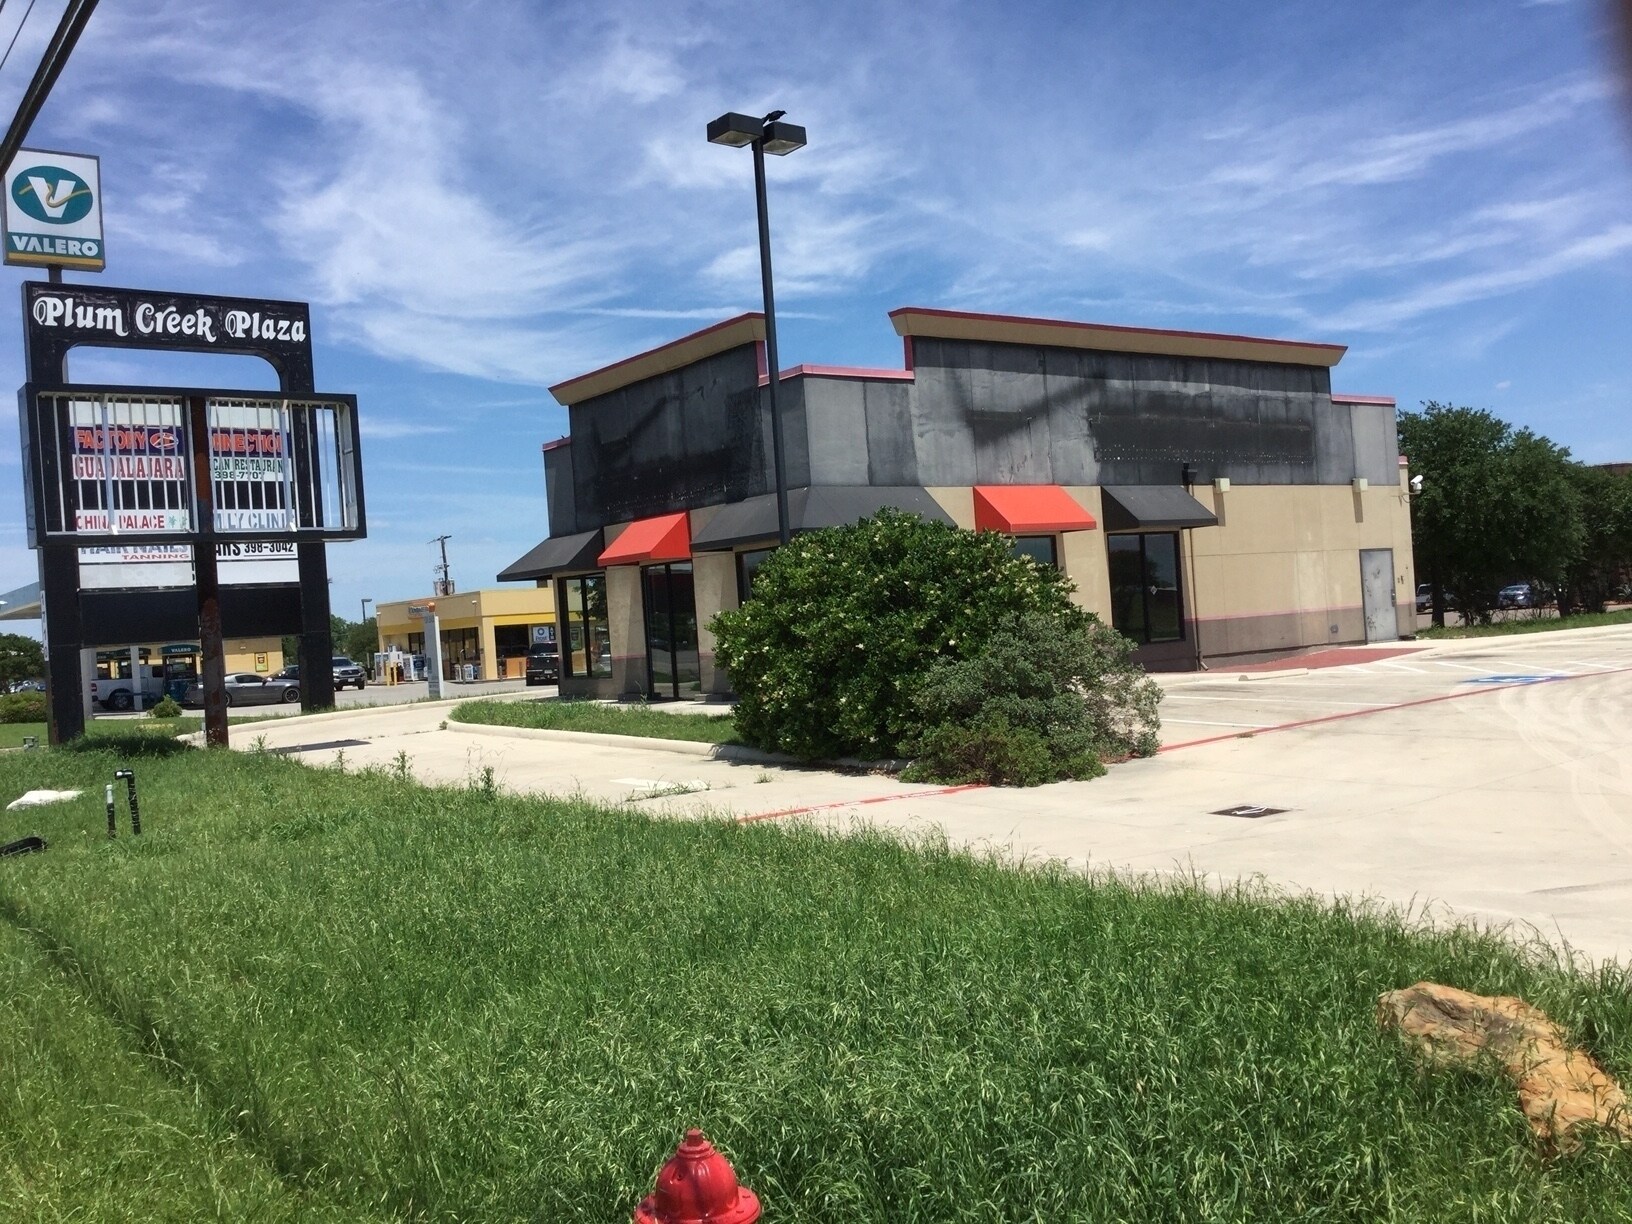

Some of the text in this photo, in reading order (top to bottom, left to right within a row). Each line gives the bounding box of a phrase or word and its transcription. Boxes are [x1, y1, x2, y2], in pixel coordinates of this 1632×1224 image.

[12, 236, 98, 257] VALERO
[33, 297, 306, 343] Plum Creek Plaza
[121, 553, 190, 561] TANNING
